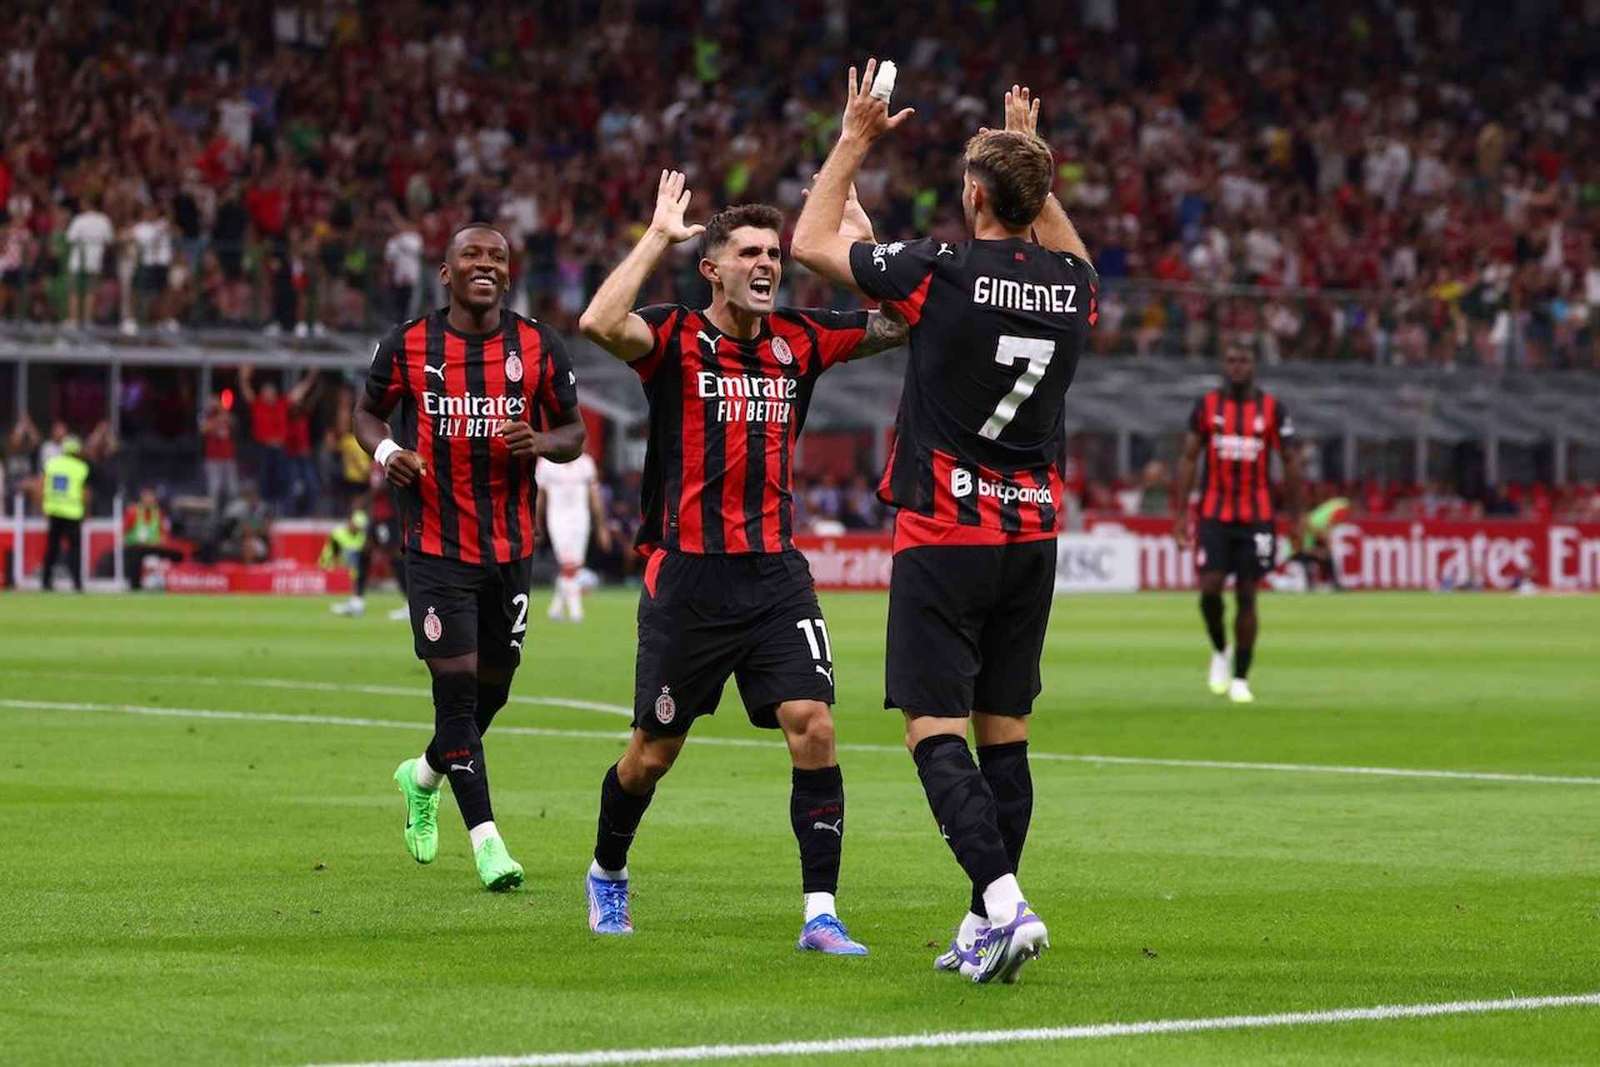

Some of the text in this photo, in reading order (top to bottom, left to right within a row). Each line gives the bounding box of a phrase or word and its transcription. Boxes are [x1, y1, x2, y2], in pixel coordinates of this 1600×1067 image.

[973, 276, 1077, 313] GIMENEZ
[422, 391, 527, 416] Emirates
[978, 334, 1056, 441] 7
[439, 418, 512, 438] FLY BETT
[717, 400, 790, 423] FLY BETTER
[978, 478, 1053, 504] bitpanda
[1330, 524, 1534, 588] Emirates
[511, 593, 528, 633] 2
[796, 618, 832, 662] 11
